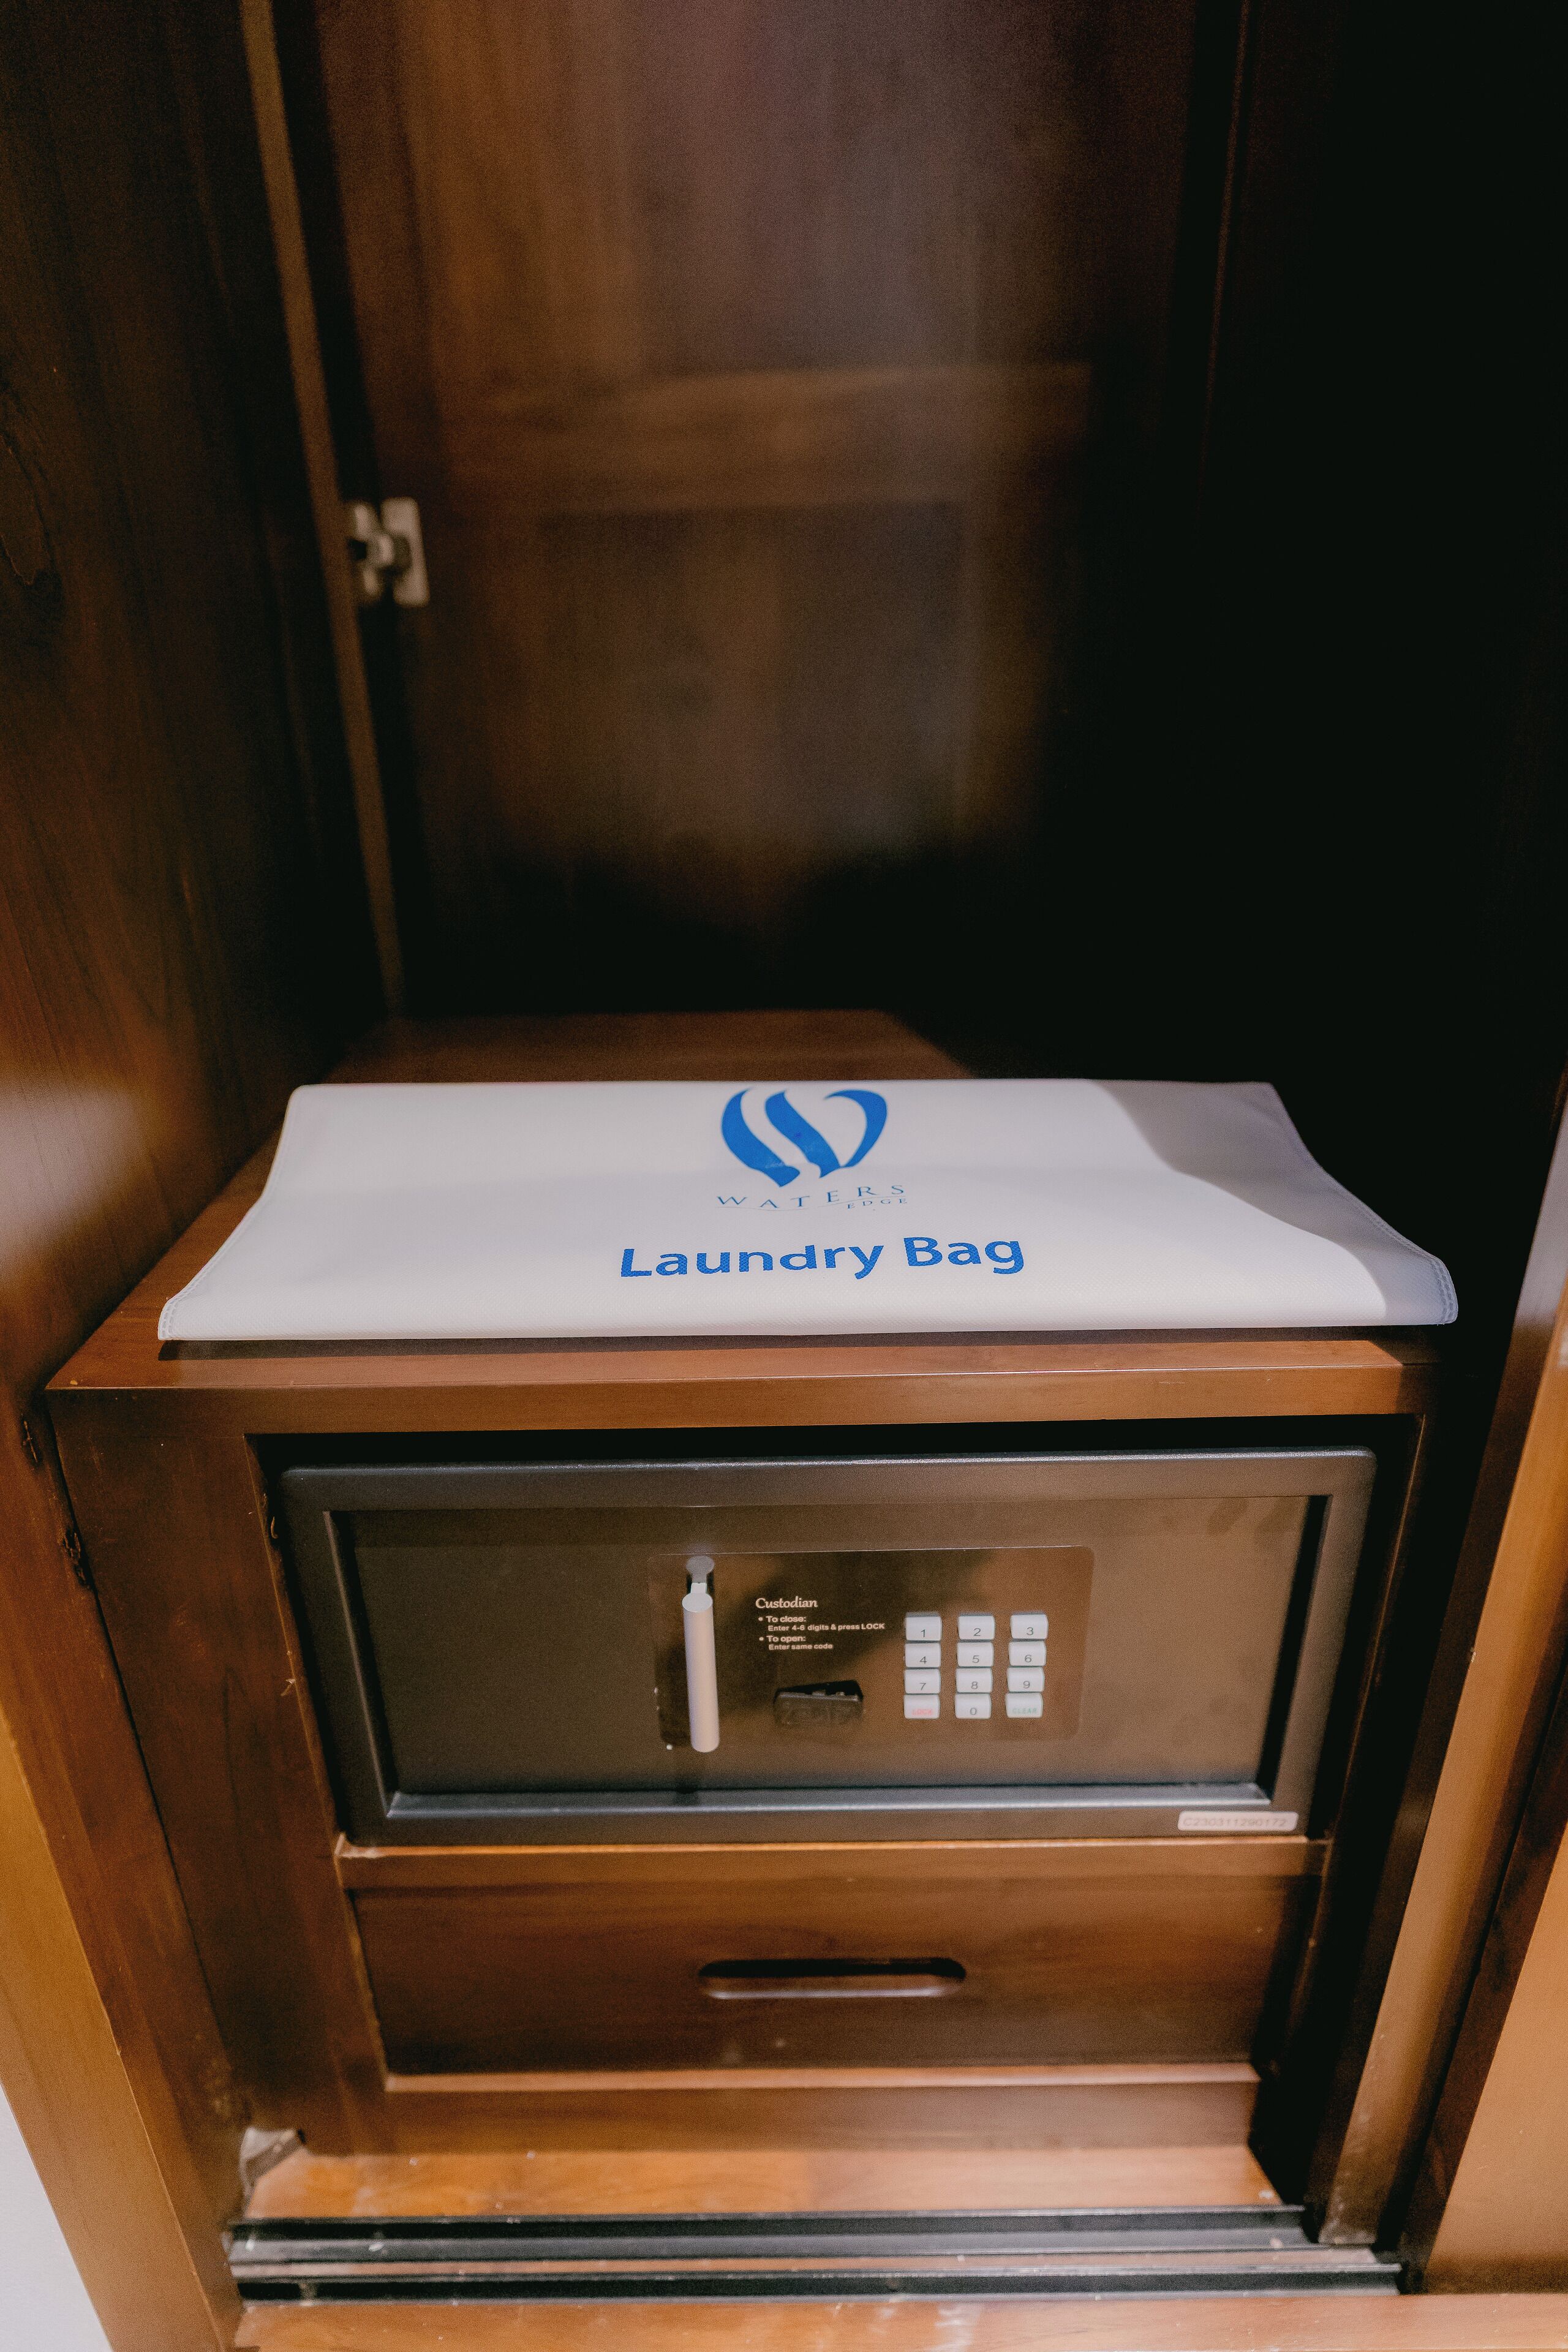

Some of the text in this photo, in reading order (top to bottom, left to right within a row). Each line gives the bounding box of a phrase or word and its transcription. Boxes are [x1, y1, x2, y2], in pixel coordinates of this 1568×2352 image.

[717, 1185, 905, 1208] WATERS
[846, 1197, 907, 1209] EDGE
[620, 1237, 1024, 1280] Laundry Bag
[755, 1596, 818, 1608] Custodian
[921, 1629, 926, 1638] 1
[973, 1628, 981, 1637] 2
[1026, 1627, 1034, 1635] 3
[1023, 1680, 1030, 1689] 9
[970, 1707, 978, 1716] 0
